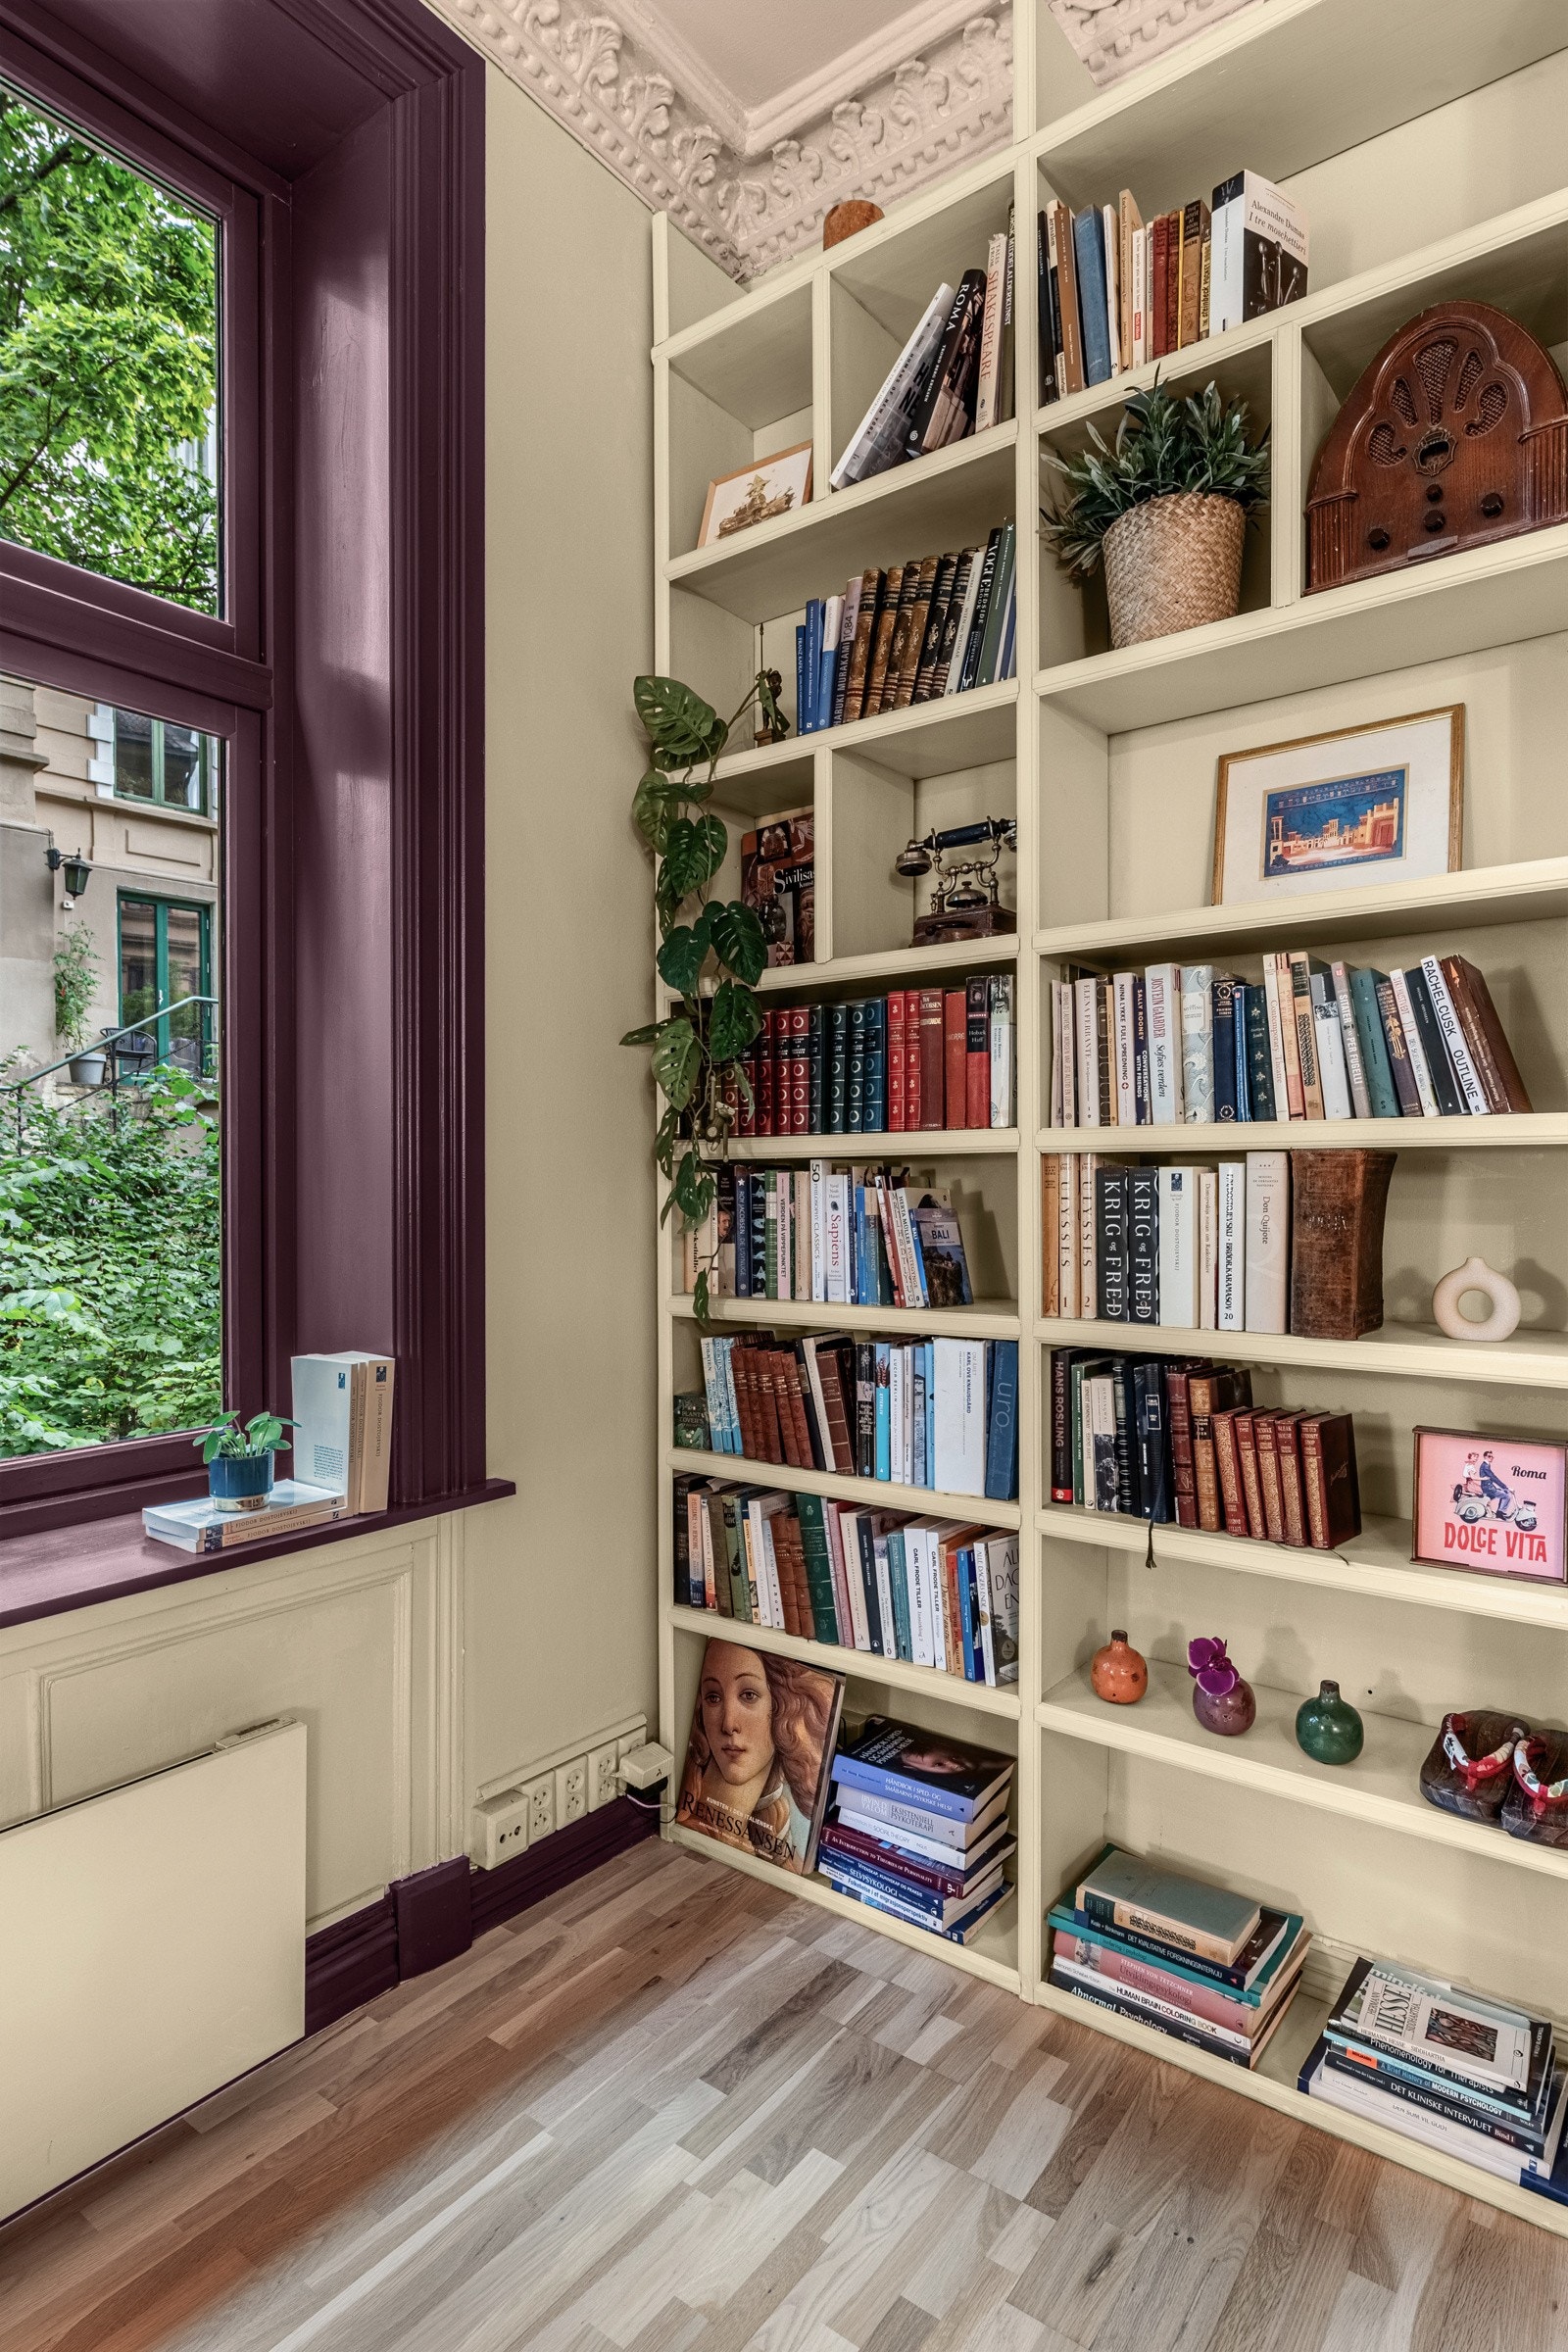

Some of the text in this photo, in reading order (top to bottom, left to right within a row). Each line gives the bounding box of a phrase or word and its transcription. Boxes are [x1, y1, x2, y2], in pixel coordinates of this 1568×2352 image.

[1252, 199, 1305, 240] Alexandre Dumas
[1255, 216, 1306, 256] tre moschettieri
[946, 283, 970, 331] ROMA
[981, 270, 999, 380] SHAKESPEARE
[981, 545, 999, 588] VOGUE
[978, 588, 991, 624] BEDSIDE
[833, 641, 851, 726] HARUKI MURAKAMI
[1152, 978, 1166, 1039] JOSTEIN GAARDER
[1270, 1000, 1283, 1084] Contemporary Theatre
[1339, 994, 1362, 1085] SITATER PER FUGELLI
[1423, 959, 1479, 1100] RACHEL CUSK OUTLINE
[1153, 1045, 1166, 1098] Sofies verden
[811, 1163, 820, 1182] 50
[828, 1214, 842, 1266] Sapiens
[903, 1218, 911, 1245] MÜLLER
[931, 1229, 950, 1240] BALI
[1060, 1181, 1071, 1267] ULYSSES
[1082, 1181, 1093, 1267] ULYSSES
[1259, 1214, 1271, 1245] Quijote
[1104, 1182, 1121, 1315] KRIG FRED
[1134, 1182, 1152, 1317] KRIG FRED
[996, 1382, 1012, 1428] uro
[1054, 1361, 1065, 1447] HANS ROSLING
[1511, 1465, 1547, 1480] Roma
[235, 1509, 298, 1529] FJODOR DOSTOJEVSKIJ
[247, 1518, 311, 1539] FJODOR DOSTOJEVSKIJ
[1444, 1522, 1547, 1562] DOLCE VITA
[977, 1565, 986, 1591] DAGERS
[885, 1777, 910, 1791] HÅNDBOK
[682, 1791, 797, 1860] RENESSANSEN
[707, 1796, 773, 1830] KUNSTEN DEN ITALIENSKE
[861, 1801, 888, 1818] YALOM
[891, 1804, 934, 1827] EKSISTENSIELL
[891, 1812, 934, 1838] PSYKOTERAPI
[937, 1801, 954, 1811] HELSE
[850, 1868, 898, 1897] SELVPSYKOLOGI
[877, 1854, 897, 1868] THEORIES
[904, 1865, 932, 1884] PERSONALITY
[848, 1877, 871, 1893] Folkehelse
[879, 1892, 928, 1922] migrasjonsperspektiv
[1120, 1958, 1194, 1995] STEPHEN VON TETZCHNER
[1127, 1935, 1223, 1978] DET KVALITATIVE FORSKNINGSINTERVJU
[1120, 1965, 1193, 2006] Utviklingspsykologi
[1367, 1991, 1380, 2016] HERMANN
[1070, 1986, 1117, 2013] Abnormal
[1119, 2005, 1168, 2034] Psychology
[1116, 1986, 1141, 2003] HUMAN
[1141, 1995, 1161, 2011] BRAIN
[1161, 2006, 1197, 2026] COLORING
[1198, 2019, 1217, 2034] BOOK
[1375, 1984, 1412, 2036] HESSE
[1407, 2002, 1421, 2033] SIDDHARTHA
[1360, 2028, 1446, 2063] HERMANN HESSE SIDDHARTHA
[1370, 2037, 1433, 2072] Phenomenology
[1434, 2063, 1446, 2075] for
[1387, 2063, 1400, 2076] Brief
[1401, 2069, 1421, 2085] History
[1432, 2082, 1459, 2100] MODERN
[1460, 2091, 1503, 2117] PSYCHOLOGY
[1391, 2082, 1493, 2134] DET KLINISKE INTERVJUET
[1494, 2129, 1508, 2140] Bind
